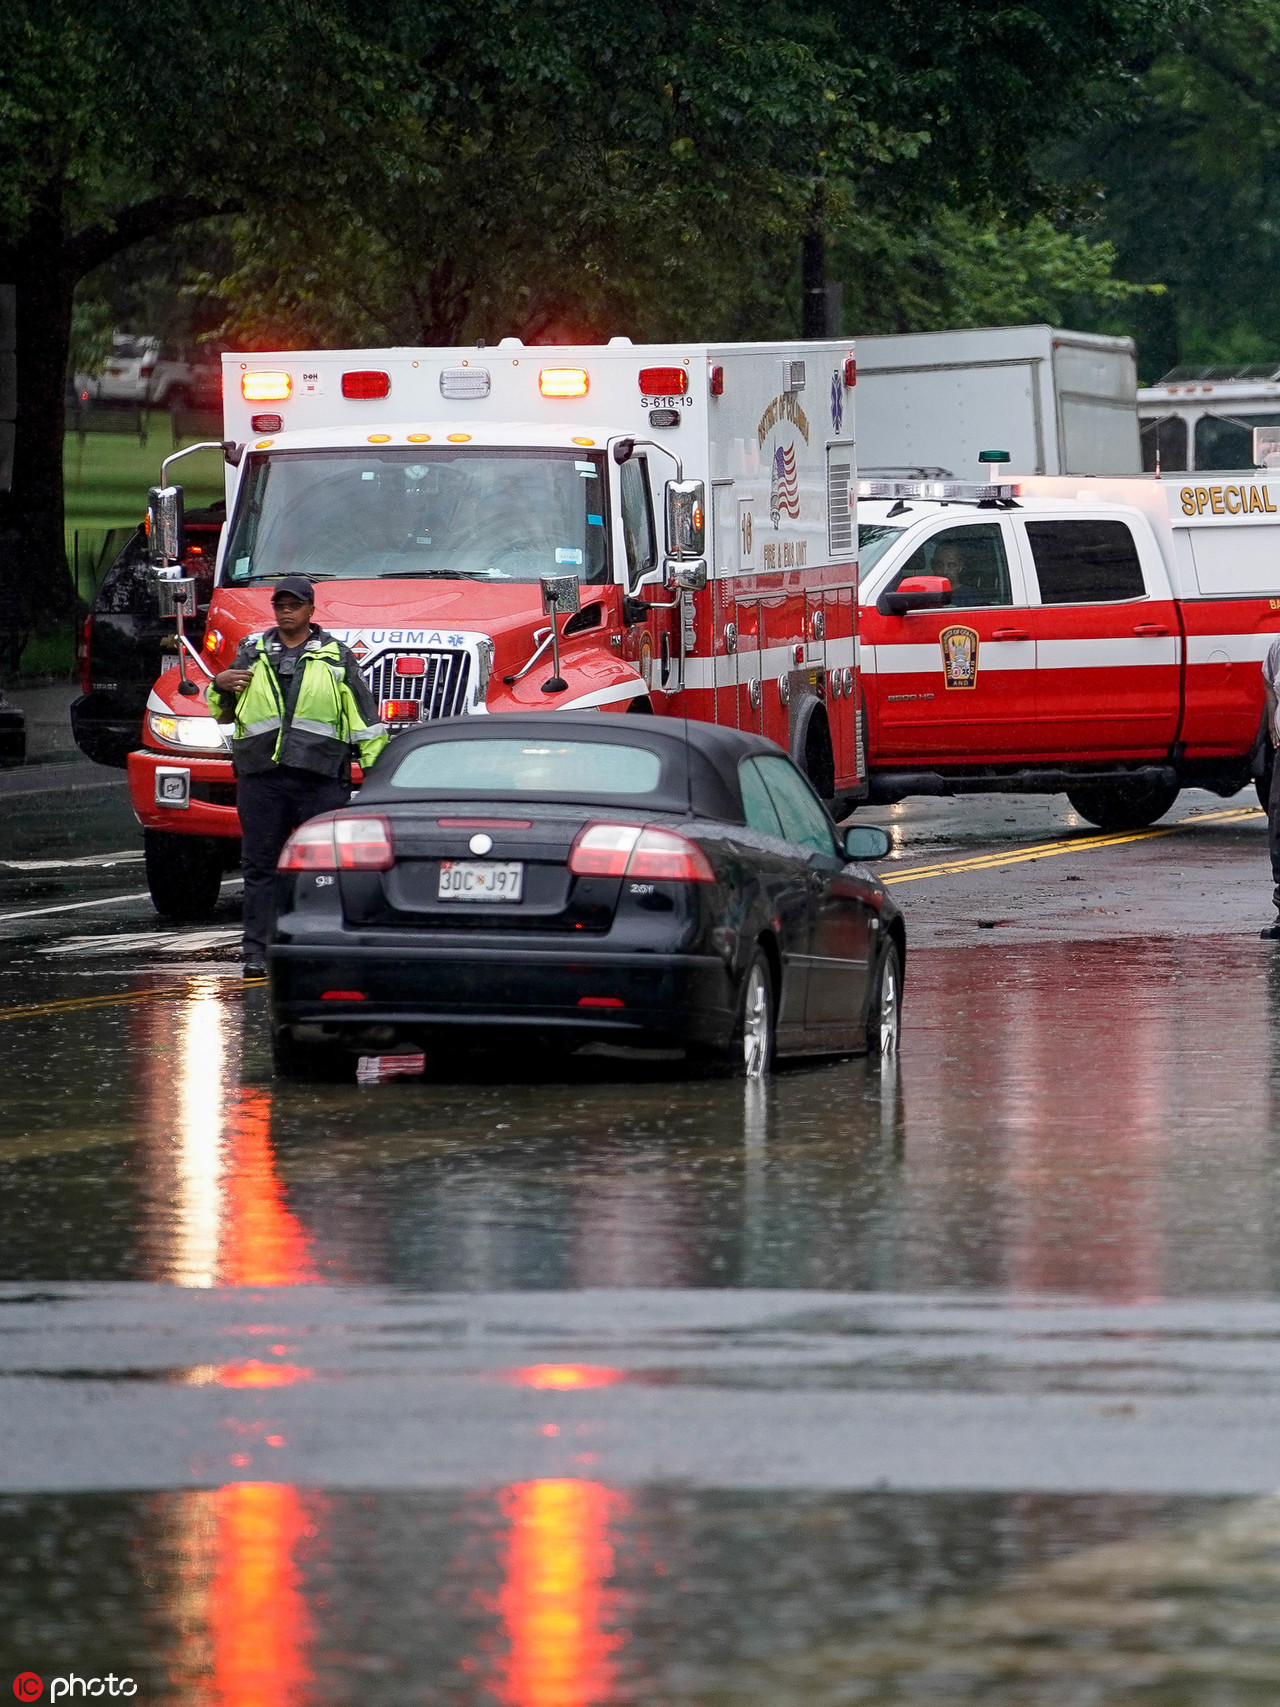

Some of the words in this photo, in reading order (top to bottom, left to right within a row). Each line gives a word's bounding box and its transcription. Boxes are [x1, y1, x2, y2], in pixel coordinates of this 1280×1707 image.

[640, 397, 693, 408] S-616-19
[1181, 486, 1277, 516] SPECIAL
[441, 871, 474, 891] 3DC
[486, 872, 519, 894] J97
